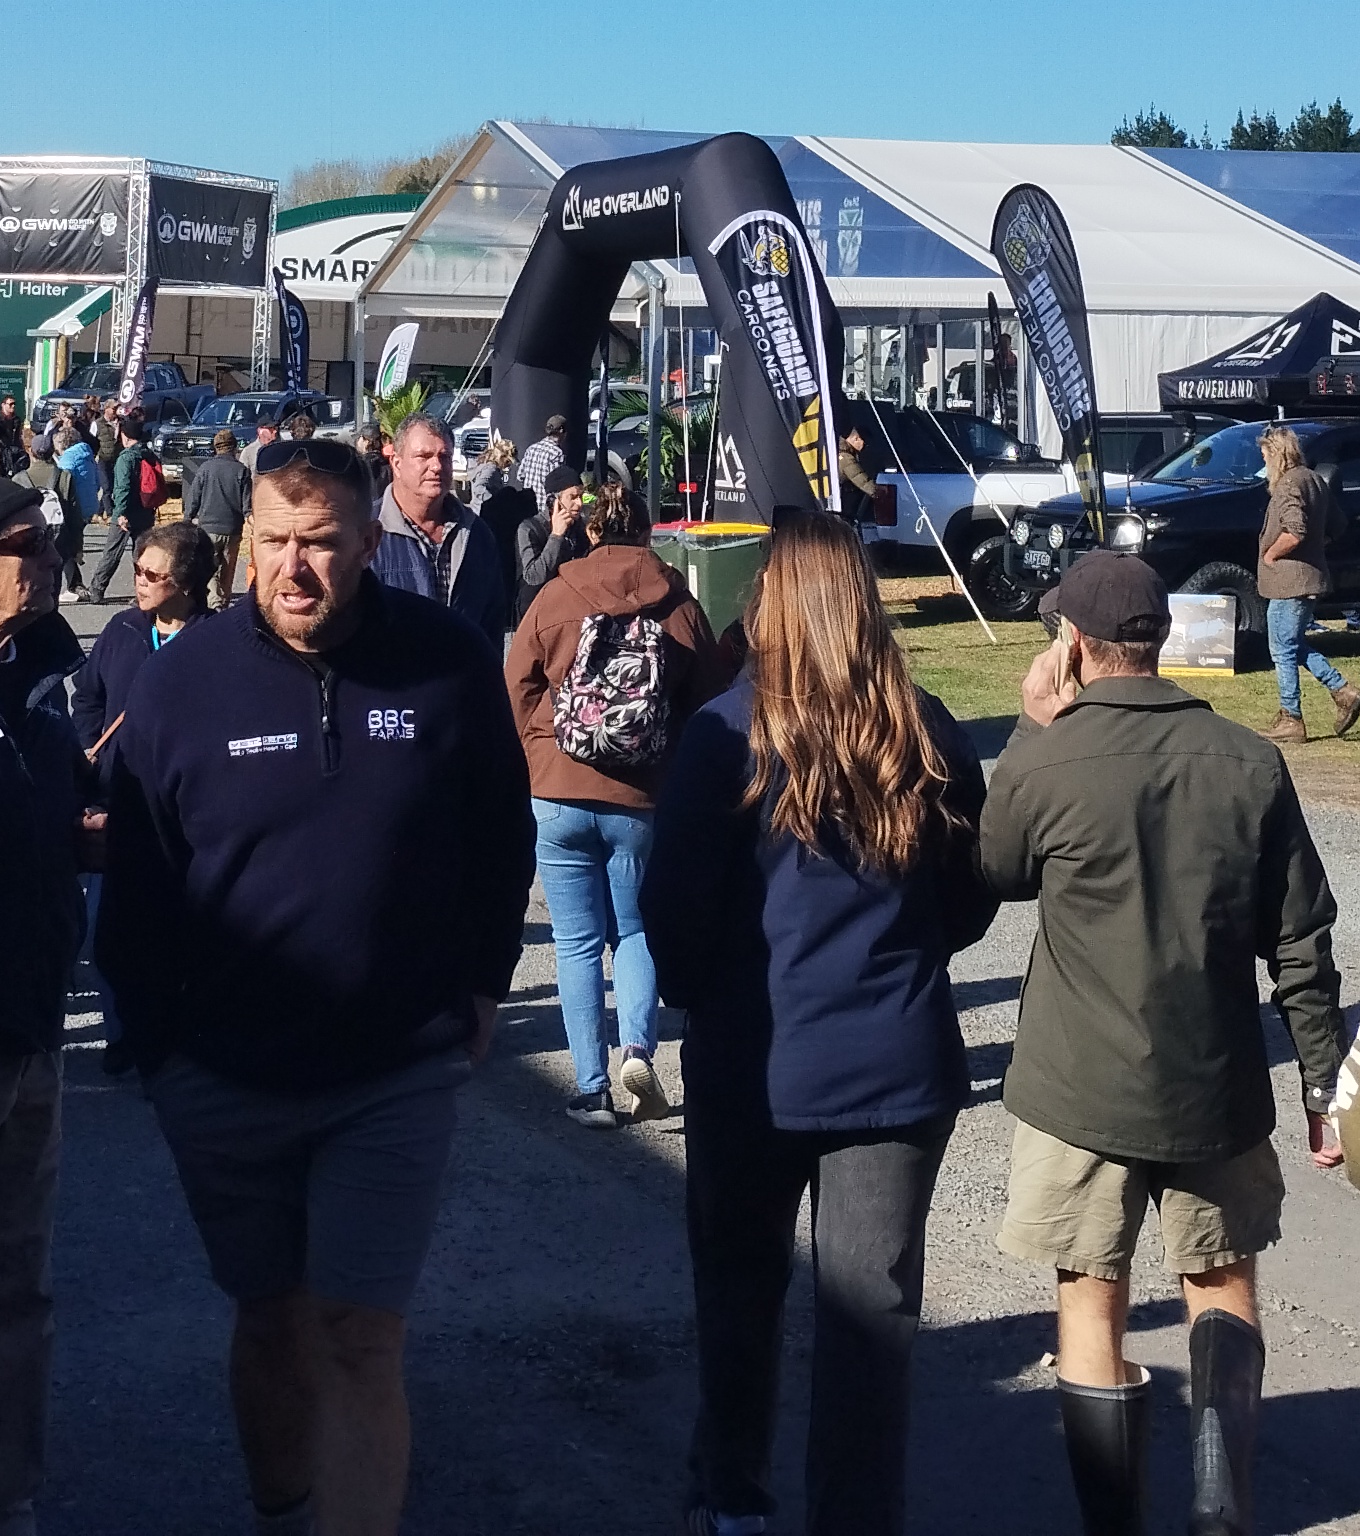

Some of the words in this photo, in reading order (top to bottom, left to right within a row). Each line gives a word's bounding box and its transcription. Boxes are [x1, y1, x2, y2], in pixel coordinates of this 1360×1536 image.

[583, 198, 600, 218] M2
[602, 185, 670, 216] OVERLAND
[22, 218, 68, 231] GWM
[178, 221, 218, 244] GWM
[19, 281, 69, 298] Halter
[737, 289, 770, 352] CARGO
[763, 355, 791, 401] NETS
[752, 280, 819, 397] SAFEGUARD
[127, 325, 146, 378] GWM
[1178, 380, 1194, 399] M2
[1196, 378, 1254, 399] OVERLAND
[368, 710, 415, 729] BBC
